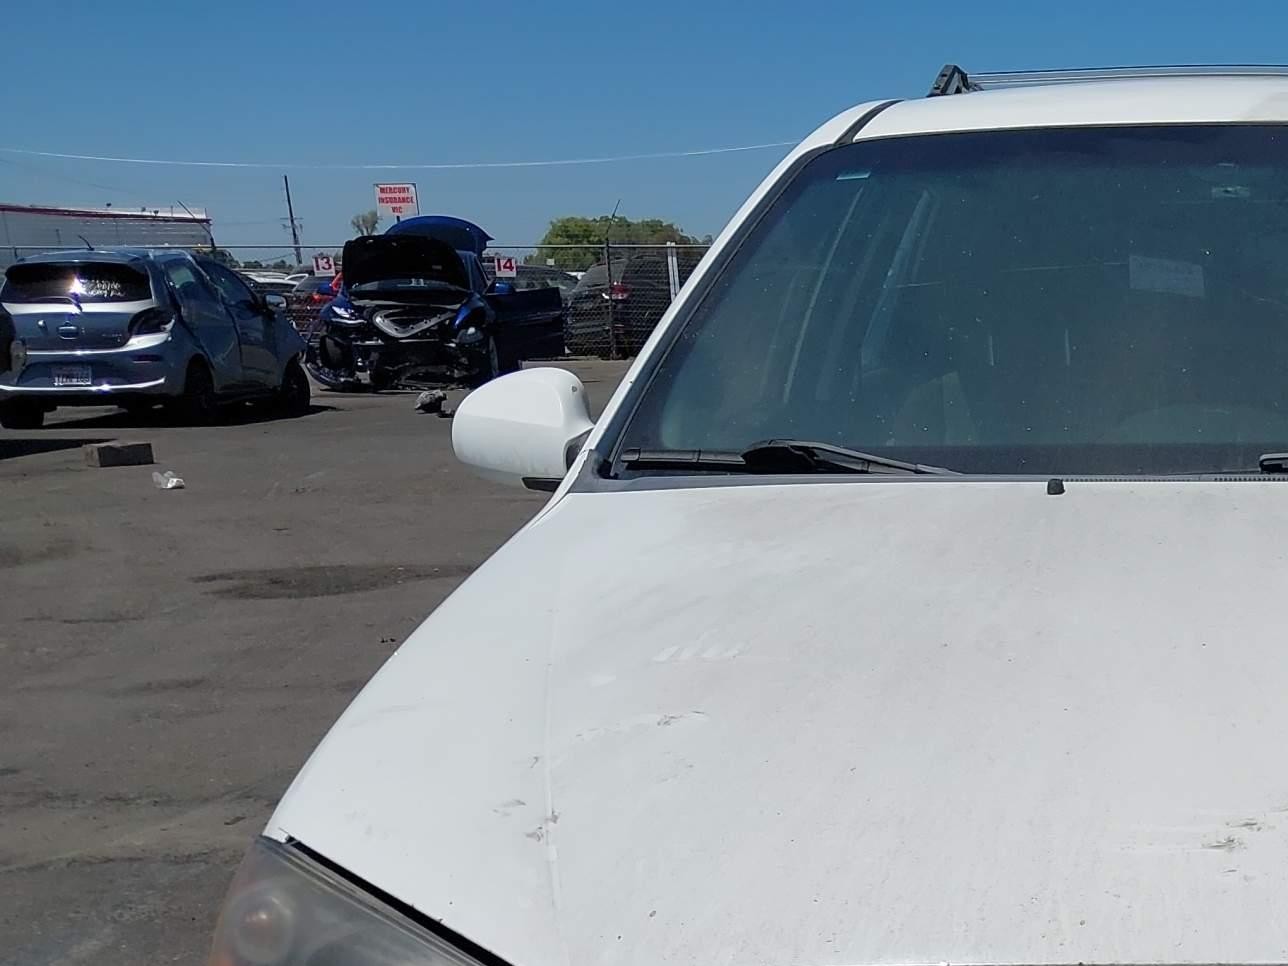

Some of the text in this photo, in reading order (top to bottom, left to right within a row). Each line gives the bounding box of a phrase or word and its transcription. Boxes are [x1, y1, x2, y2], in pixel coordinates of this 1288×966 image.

[379, 186, 410, 194] MERCURY
[378, 196, 414, 204] INSURANCE
[314, 256, 333, 271] 13
[496, 257, 515, 271] 14
